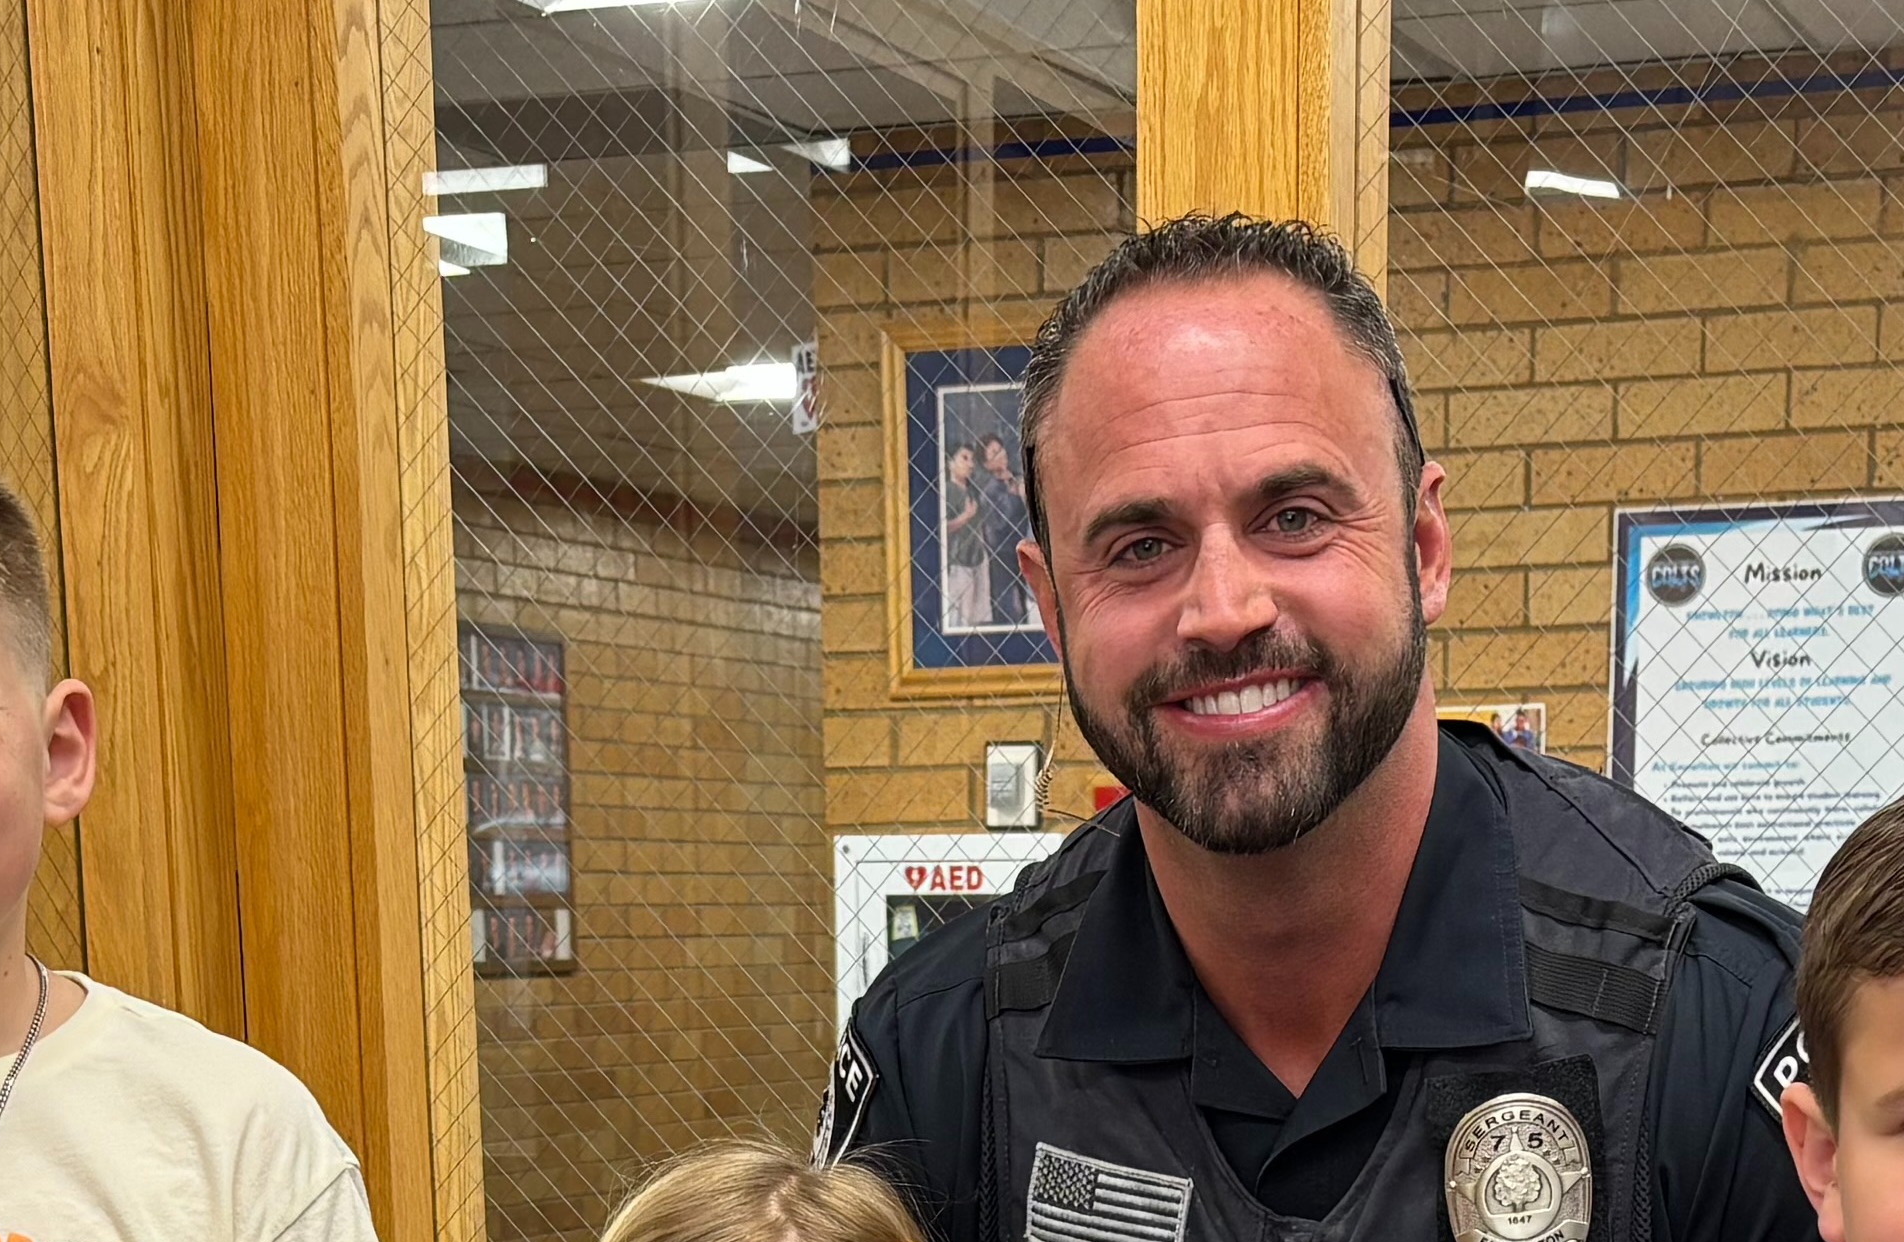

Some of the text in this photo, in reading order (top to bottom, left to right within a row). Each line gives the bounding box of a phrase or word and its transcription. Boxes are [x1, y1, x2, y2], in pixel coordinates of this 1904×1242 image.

[1651, 563, 1701, 590] COLTS
[1745, 562, 1823, 584] Mission
[1752, 650, 1812, 668] Vision
[929, 865, 984, 891] AED
[1466, 1110, 1568, 1152] SERGEANT
[1490, 1132, 1544, 1150] 7 5
